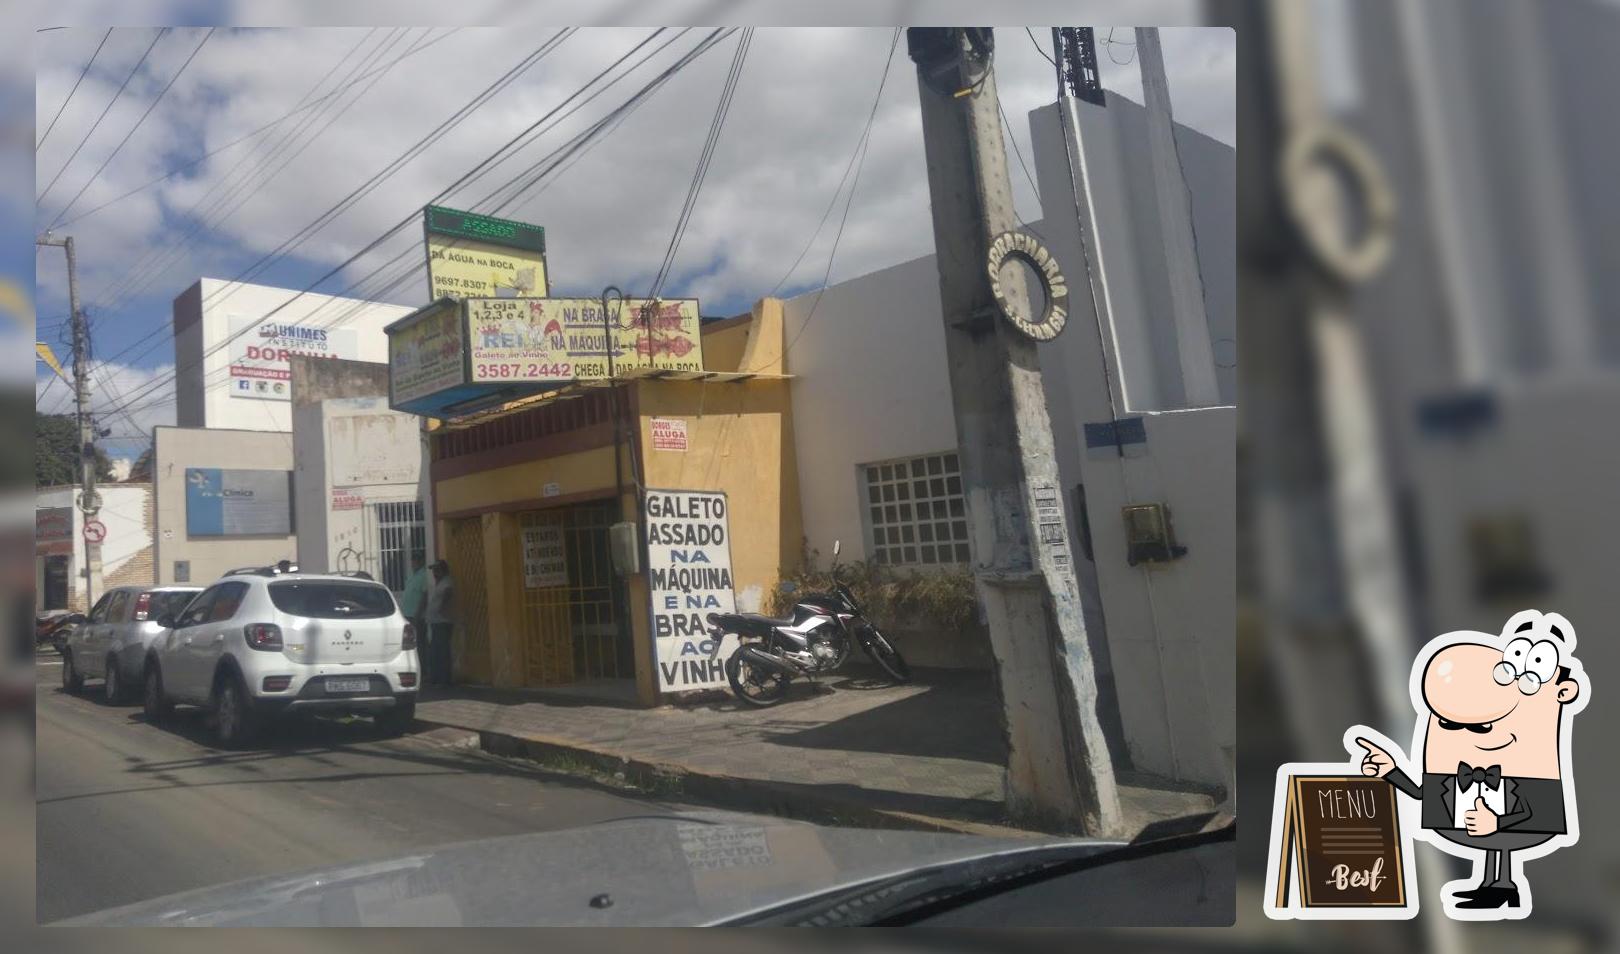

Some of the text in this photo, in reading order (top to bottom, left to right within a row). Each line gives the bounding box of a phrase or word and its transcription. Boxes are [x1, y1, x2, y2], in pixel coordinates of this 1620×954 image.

[490, 259, 515, 271] BOCA
[434, 276, 487, 290] 9697.8307
[483, 301, 517, 312] Loja
[517, 310, 525, 320] 4
[563, 307, 618, 323] NA BRAA
[279, 324, 328, 341] UNIMES
[484, 333, 523, 348] REI
[551, 335, 621, 351] NA MAQUIA
[474, 351, 505, 360] Galeto
[522, 351, 548, 359] Vinho
[477, 363, 571, 378] 3587.2442
[574, 363, 606, 377] CHEGA
[653, 430, 686, 439] ALUGA
[646, 495, 725, 520] GALETO
[647, 523, 725, 546] ASSADO
[670, 549, 711, 564] NA
[651, 564, 734, 594] MÁQUINA
[664, 595, 721, 610] E NA
[660, 657, 727, 686] VINH
